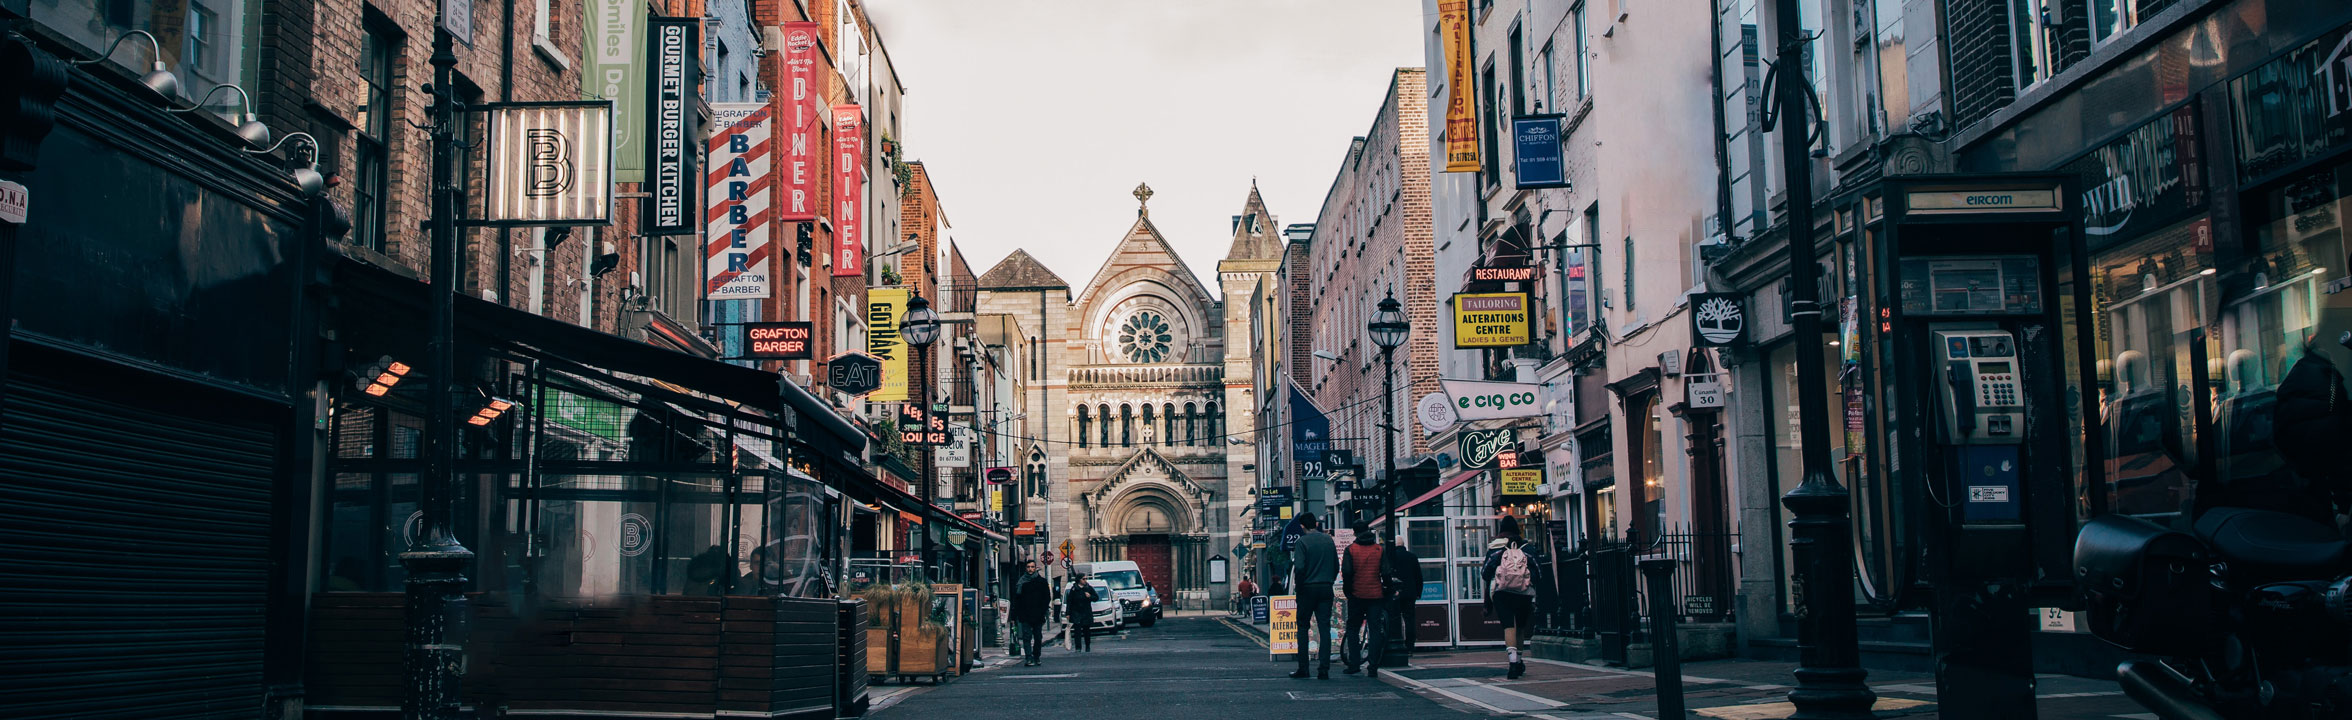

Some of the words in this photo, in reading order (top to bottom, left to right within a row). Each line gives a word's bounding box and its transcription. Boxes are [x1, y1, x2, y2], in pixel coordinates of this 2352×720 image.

[663, 25, 681, 96] GOURMET
[1452, 22, 1464, 115] ALTERATION
[662, 100, 679, 157] BURGER
[1448, 121, 1474, 139] CENTRE
[792, 77, 807, 214] DINER
[1518, 134, 1555, 142] CHIFFON
[526, 129, 574, 198] B
[661, 162, 677, 227] KITCHEN
[728, 133, 751, 273] BARBER
[841, 153, 854, 269] DINER
[1476, 267, 1531, 280] RESTAURANT
[1466, 297, 1518, 310] TAILORING
[1462, 312, 1524, 324] ALTERATIONS
[750, 328, 808, 339] GRAFTON
[1476, 324, 1511, 335] CENTRE
[753, 341, 804, 352] BARBER
[1497, 335, 1525, 343] GENTS
[831, 363, 877, 387] EAT
[1458, 395, 1470, 409] e
[1474, 394, 1505, 411] cig
[1510, 392, 1535, 406] co
[1700, 396, 1715, 404] 30
[932, 404, 948, 412] NES
[901, 432, 945, 443] LOUGE
[1295, 442, 1328, 450] MAGEE
[1304, 461, 1324, 478] 22
[1500, 460, 1517, 468] BAR
[624, 523, 641, 548] B
